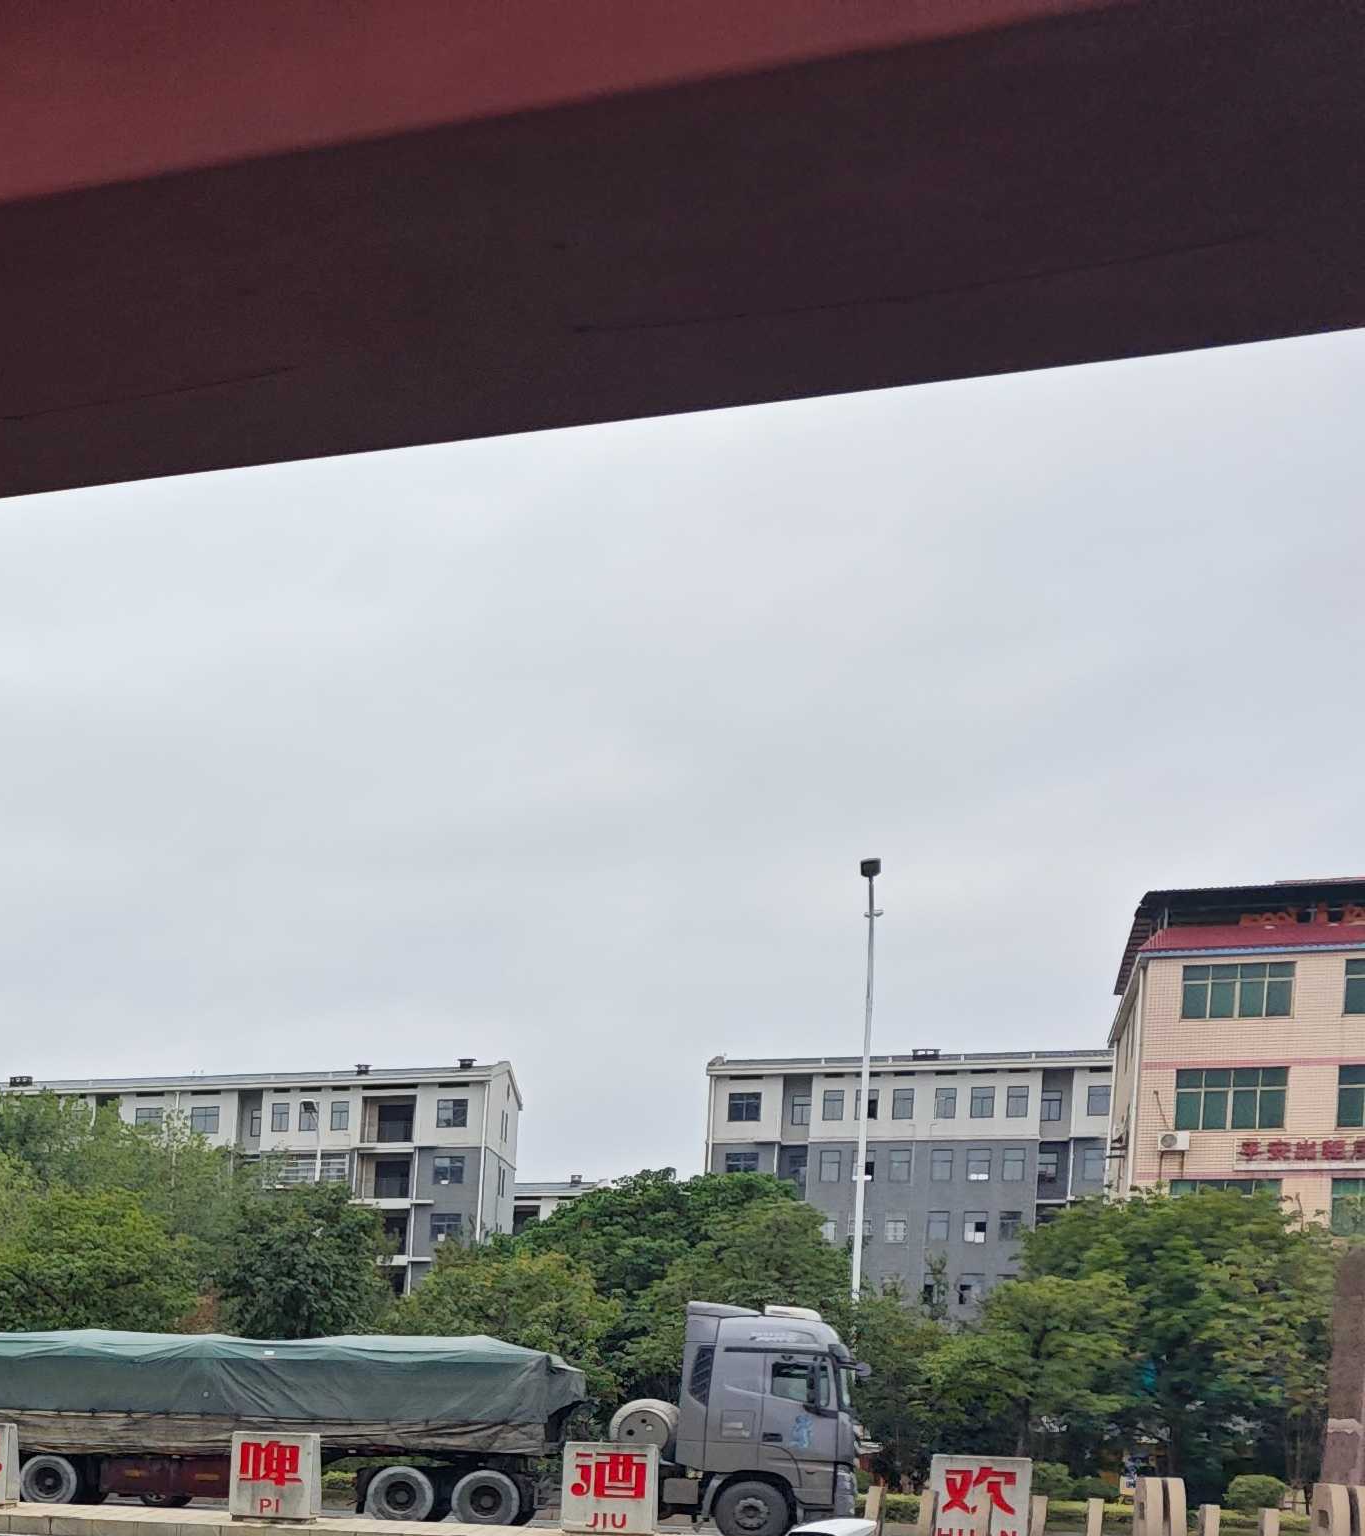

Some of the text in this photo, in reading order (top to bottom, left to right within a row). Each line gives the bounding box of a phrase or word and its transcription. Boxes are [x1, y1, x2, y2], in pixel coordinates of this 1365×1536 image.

[239, 1441, 303, 1486] 啤
[571, 1453, 647, 1499] 酒
[259, 1498, 280, 1513] PI
[942, 1467, 1017, 1515] 欢
[586, 1512, 627, 1529] JIU
